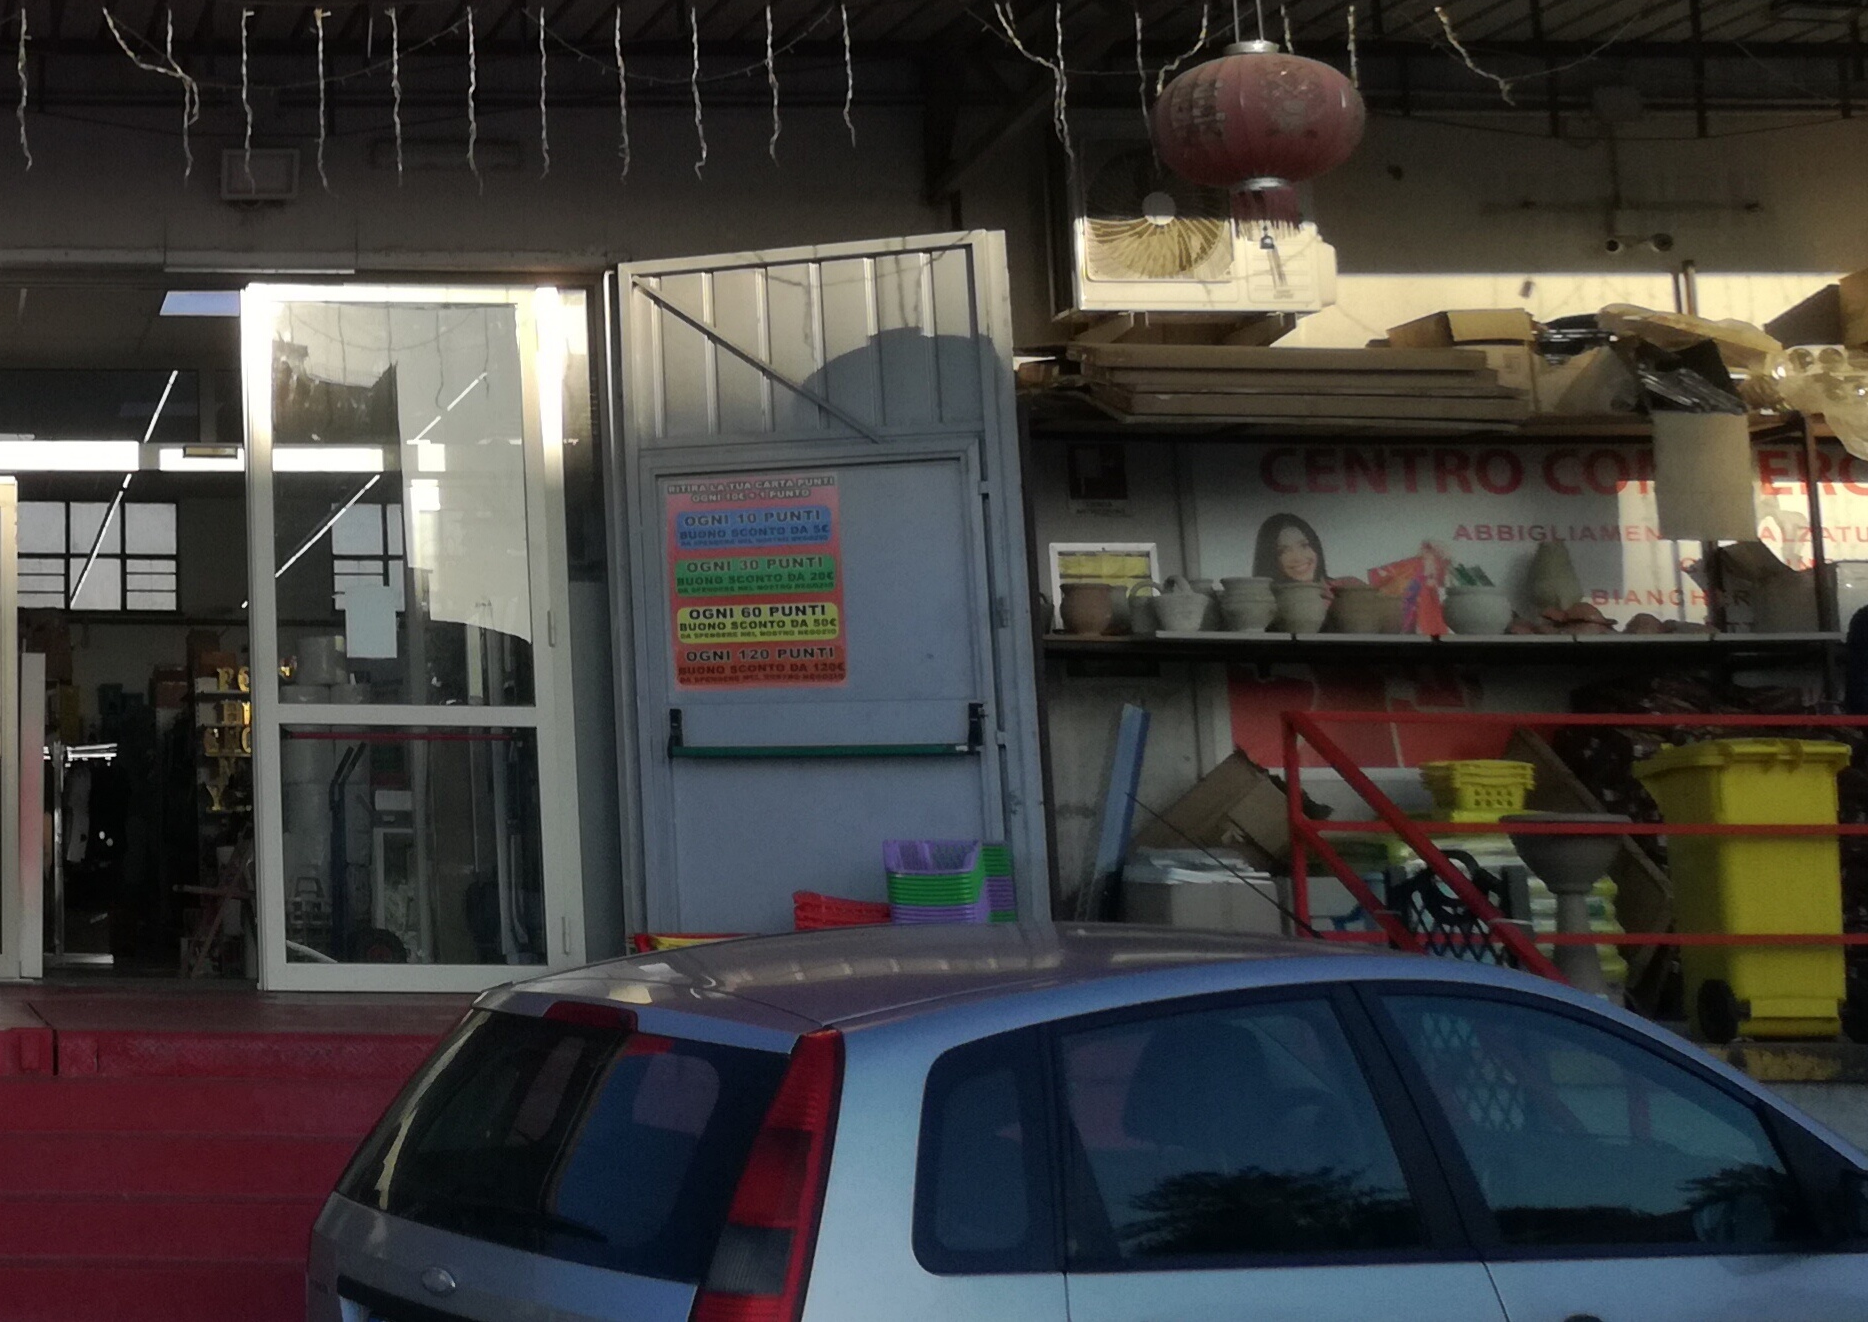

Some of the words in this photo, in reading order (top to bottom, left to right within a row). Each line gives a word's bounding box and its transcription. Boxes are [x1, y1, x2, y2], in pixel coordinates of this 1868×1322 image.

[1258, 447, 1525, 495] CENTRO
[797, 477, 834, 488] PUNTI
[684, 514, 730, 527] OGNI
[737, 512, 757, 524] 10
[764, 510, 821, 522] PUNTI
[679, 530, 726, 540] BUONO
[731, 526, 786, 538] SCONTO
[790, 524, 809, 534] DA
[1453, 524, 1662, 542] ABBIGLIAMEN
[686, 561, 731, 573] OGNI
[739, 559, 760, 571] 30
[766, 557, 823, 570] PUNTI
[676, 576, 724, 587] BUONO
[728, 573, 783, 584] SCONTO
[787, 572, 805, 582] DA
[688, 608, 734, 620] OGNI
[740, 606, 762, 618] 60
[769, 604, 826, 617] PUNTI
[679, 622, 727, 632] BUONO
[730, 620, 786, 630] SCONTO
[790, 619, 809, 628] DA
[686, 650, 731, 663] OGNI
[738, 648, 770, 660] 120
[777, 647, 835, 660] PUNTI
[678, 665, 725, 675] BUONO
[730, 664, 785, 674] SCONTO
[790, 663, 808, 672] DA
